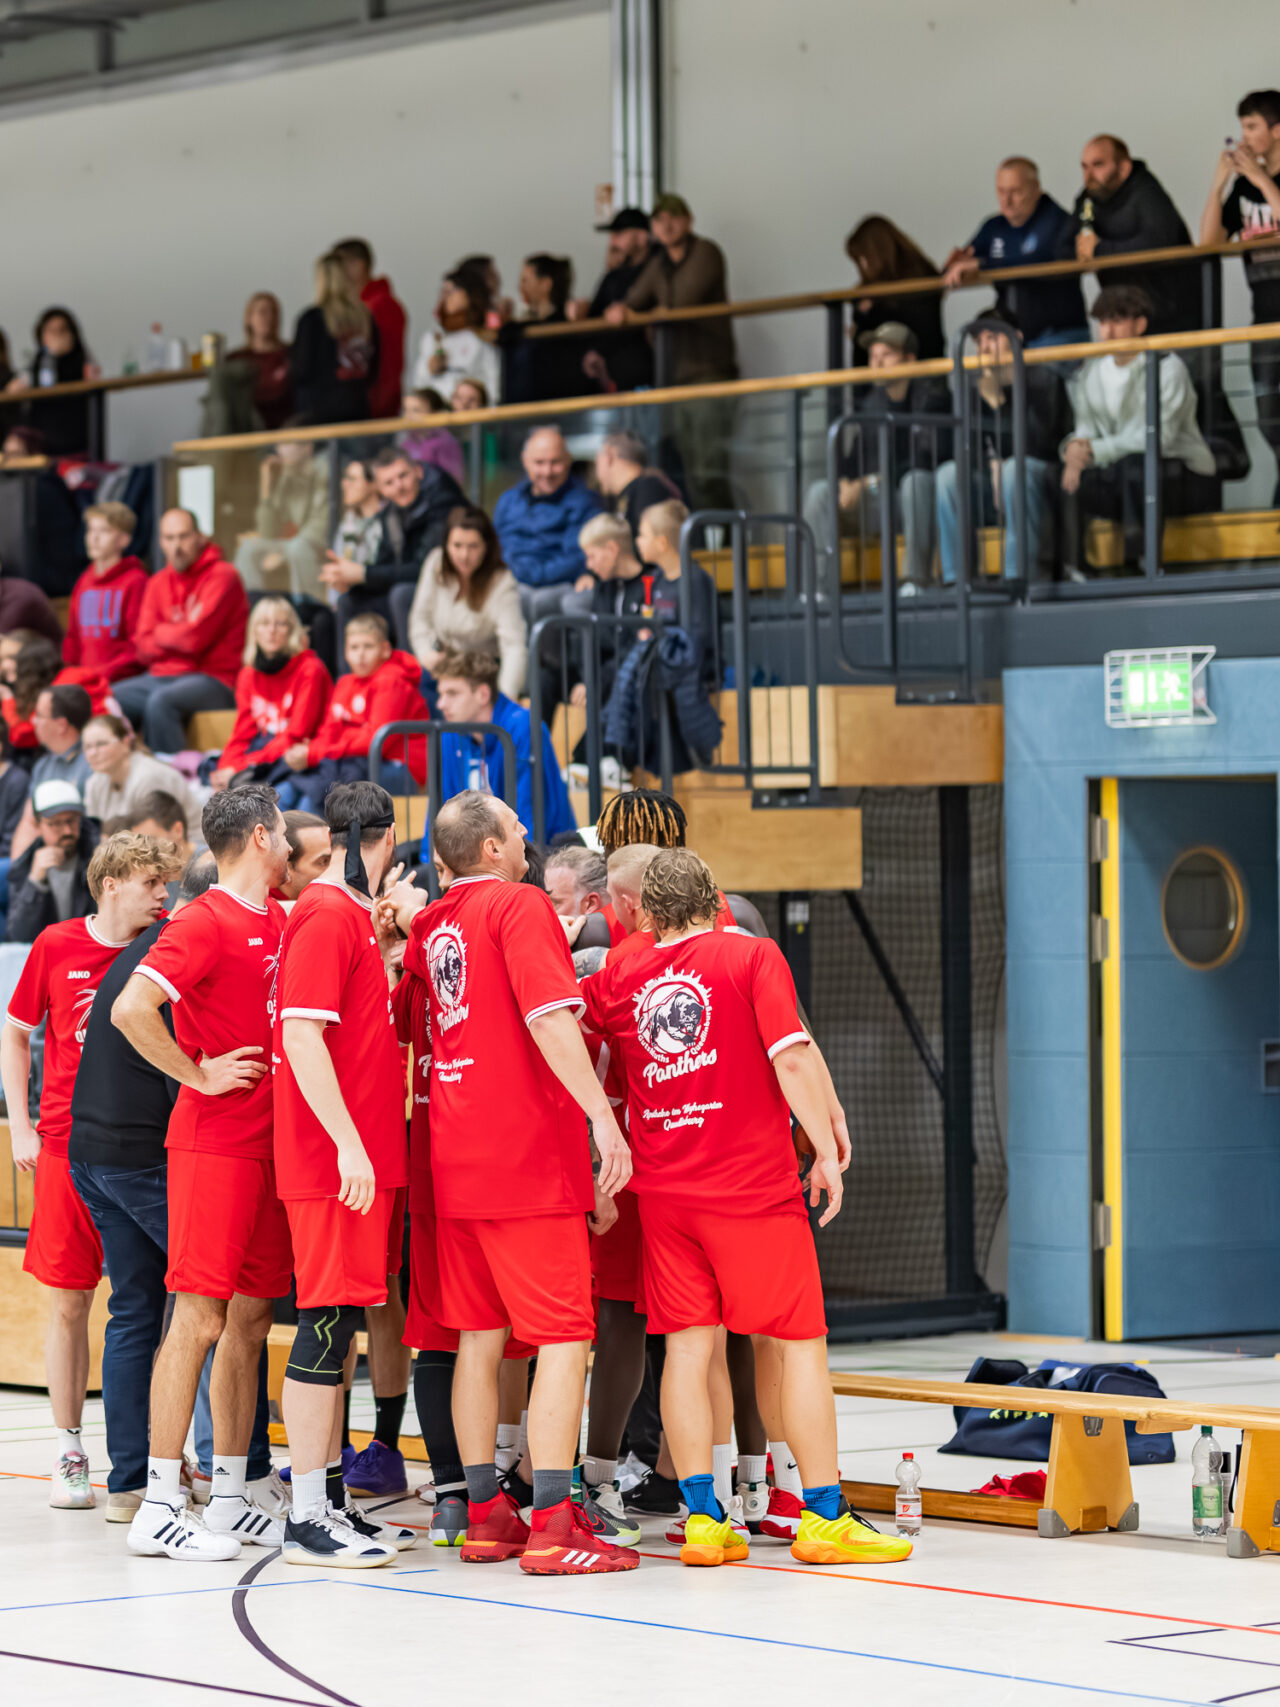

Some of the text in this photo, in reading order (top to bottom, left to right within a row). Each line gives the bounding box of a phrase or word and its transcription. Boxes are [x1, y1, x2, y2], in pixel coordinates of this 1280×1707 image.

[67, 970, 91, 979] JAKO
[690, 1005, 713, 1055] Quedlinburg
[642, 1048, 717, 1088] Panthers
